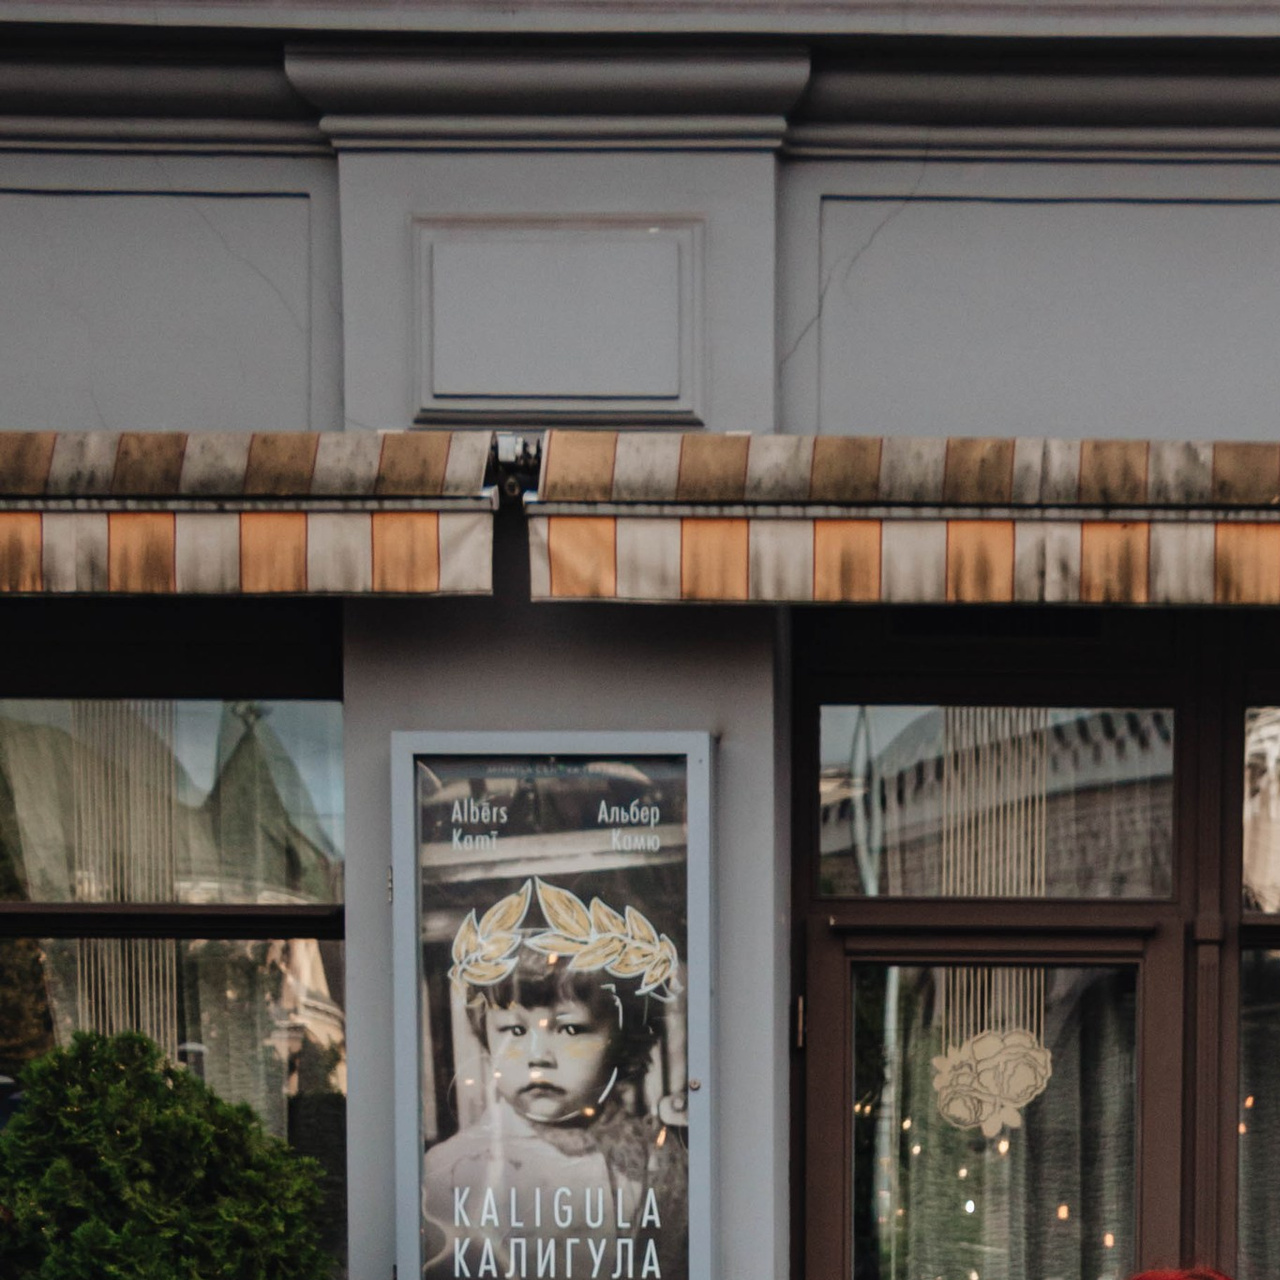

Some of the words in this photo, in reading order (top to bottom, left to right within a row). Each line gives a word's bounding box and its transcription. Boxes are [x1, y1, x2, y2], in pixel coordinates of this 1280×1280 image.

[451, 798, 508, 823] Albērs
[598, 798, 660, 829] Альбер
[452, 828, 498, 851] Kamī
[611, 829, 660, 851] Камю
[453, 1187, 661, 1228] KALIGULA
[453, 1237, 661, 1279] КАЛИГУЛА
